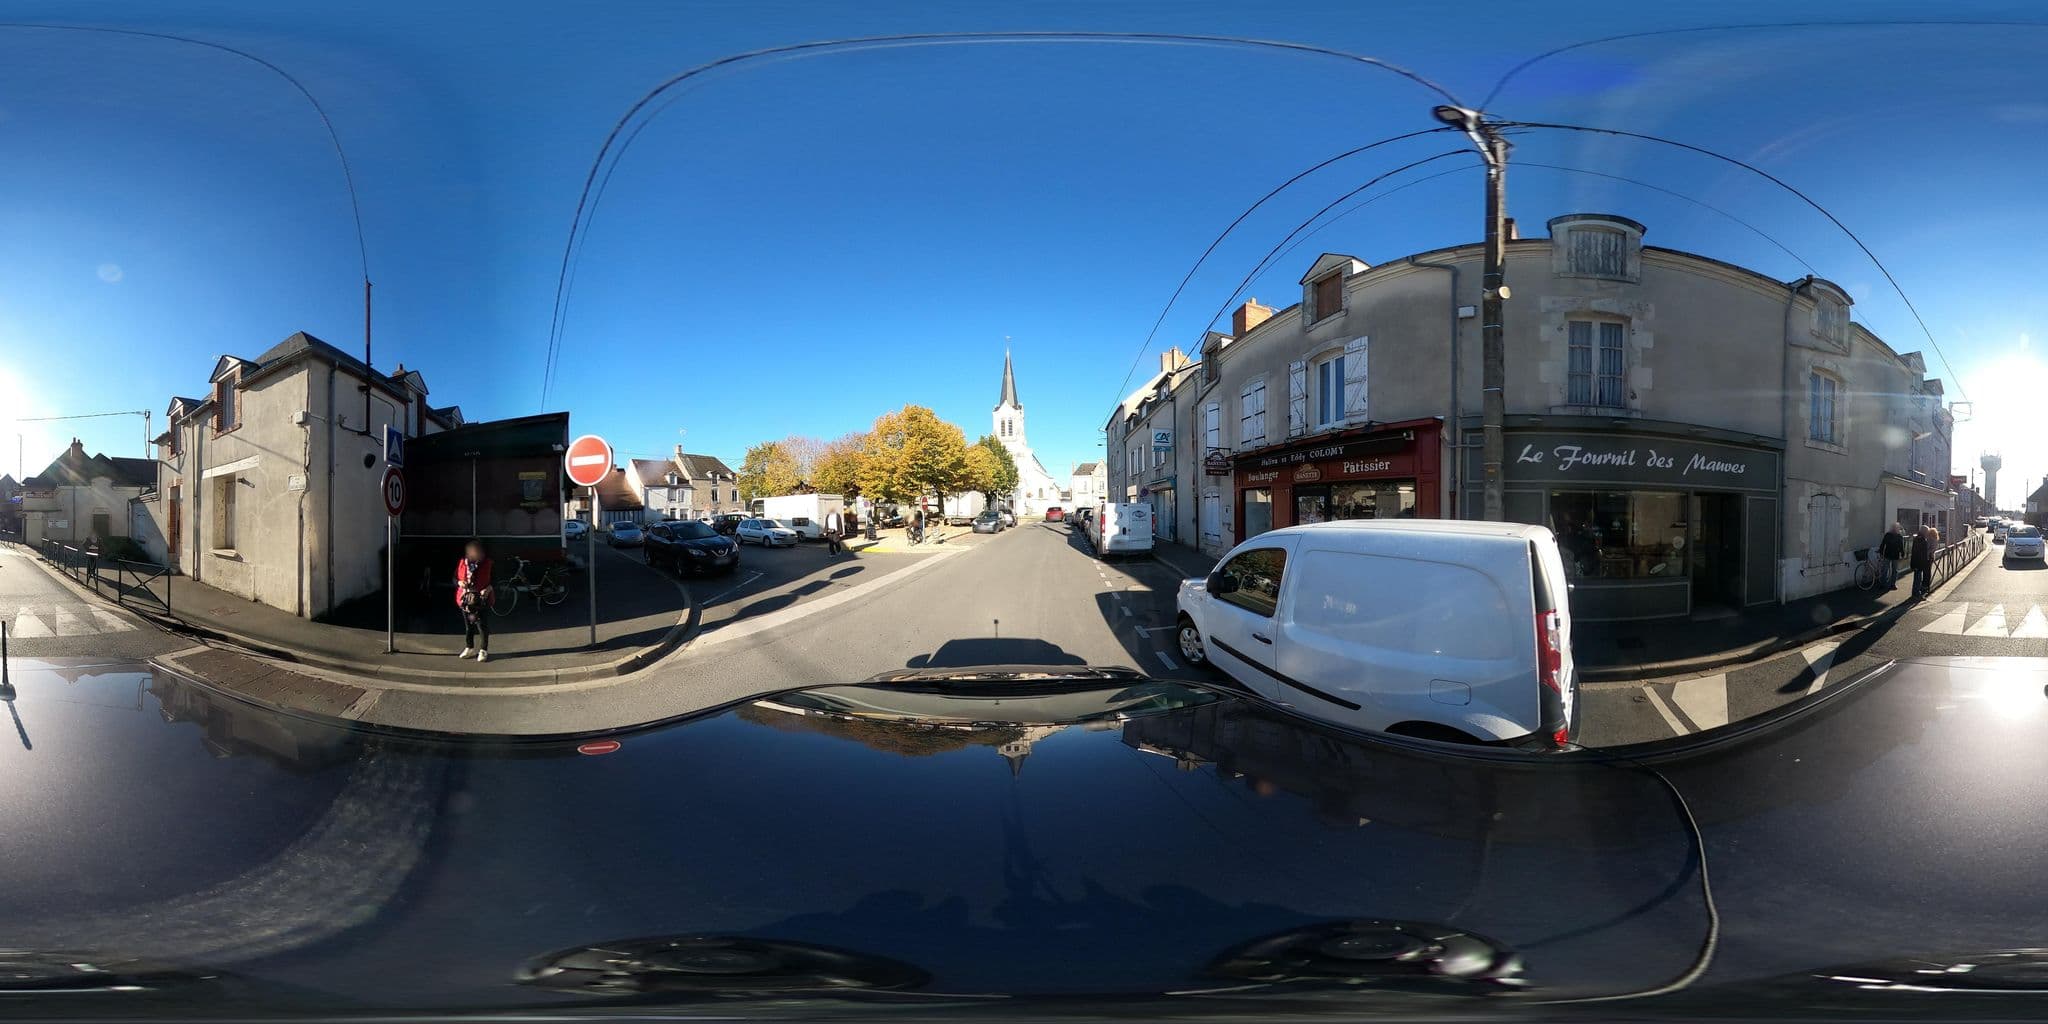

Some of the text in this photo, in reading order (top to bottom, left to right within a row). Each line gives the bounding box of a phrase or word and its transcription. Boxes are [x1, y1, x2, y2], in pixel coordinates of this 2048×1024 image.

[1290, 452, 1306, 462] Eddy
[1309, 446, 1344, 459] COLOMY
[1516, 444, 1746, 475] Le Fournil des Mauves
[1343, 458, 1391, 474] Pâtissier
[1248, 470, 1279, 482] Boulanger
[390, 481, 401, 502] 10
